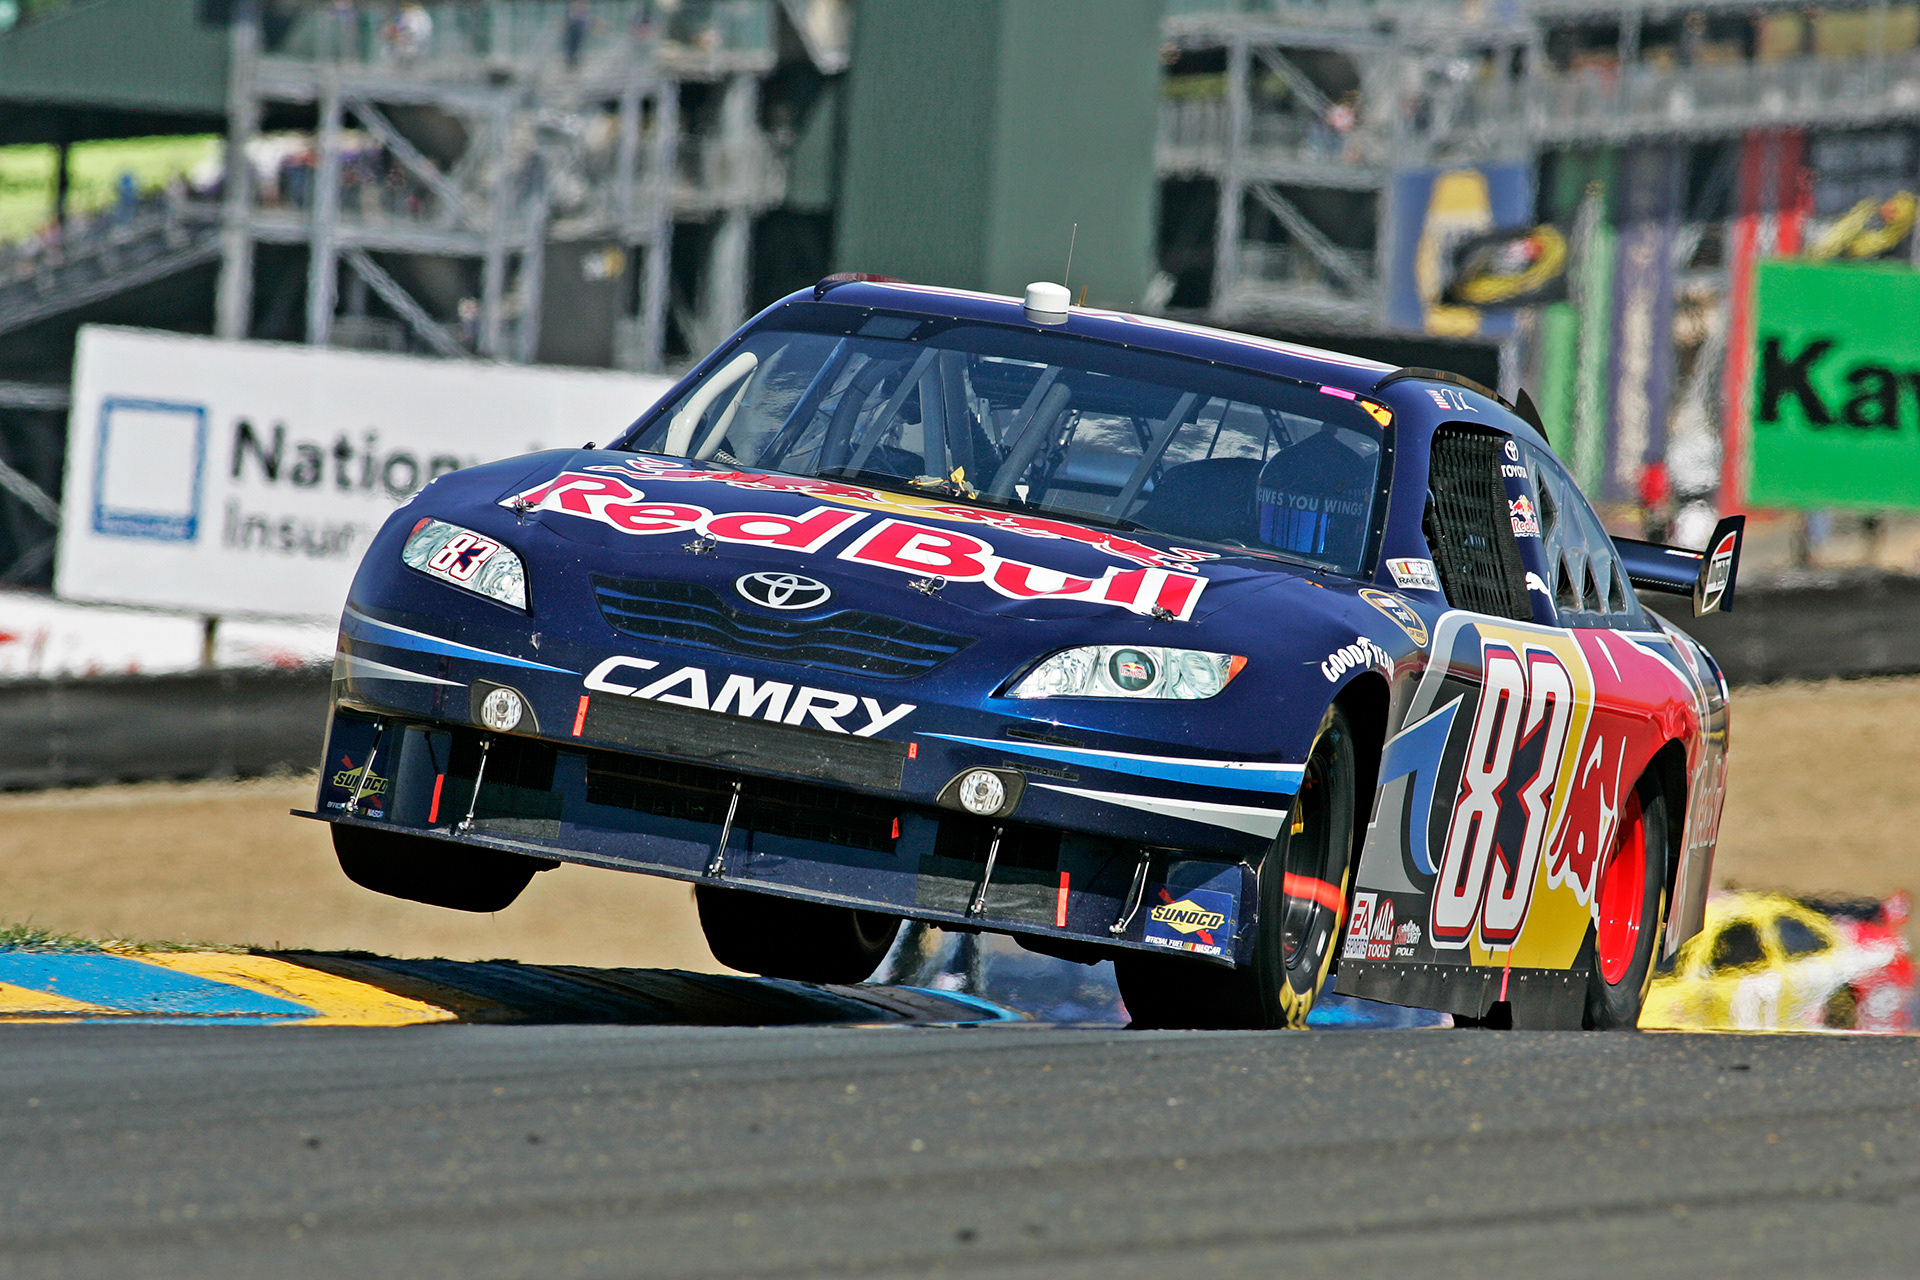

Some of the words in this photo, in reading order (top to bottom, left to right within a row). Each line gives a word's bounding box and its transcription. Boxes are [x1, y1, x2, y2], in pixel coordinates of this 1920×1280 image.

[1501, 464, 1528, 479] TOYOTA
[1257, 486, 1284, 506] GIVES
[1288, 494, 1319, 512] YOU
[1324, 499, 1363, 516] WINGS
[427, 532, 500, 582] 83
[498, 471, 871, 554] Red
[836, 517, 1210, 622] Bull
[1321, 636, 1395, 683] GOODYEAR
[583, 655, 918, 738] CAMRY
[1429, 637, 1576, 951] 83
[1152, 905, 1223, 928] SUNOCO
[1370, 900, 1394, 941] MAC
[1144, 935, 1168, 946] OFFICIAL
[1168, 938, 1184, 948] FUEL
[1194, 942, 1222, 956] NASCAR
[1367, 943, 1391, 958] TOOLS
[1394, 947, 1415, 957] POLE
